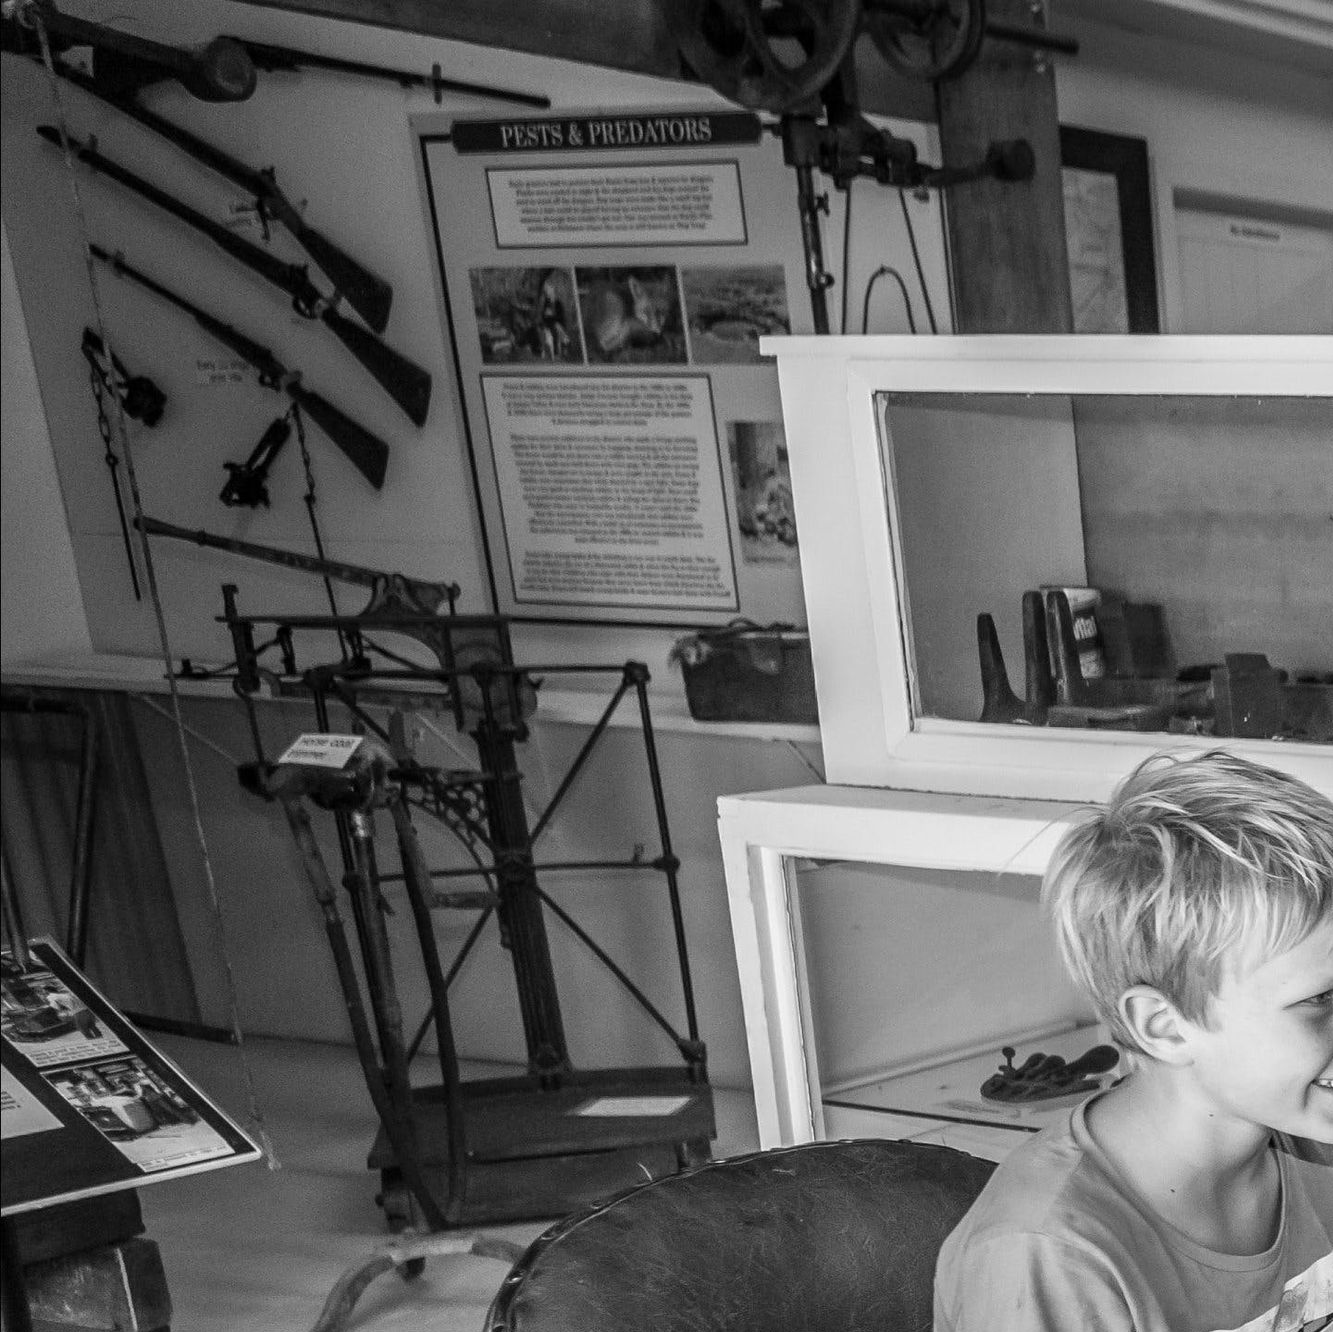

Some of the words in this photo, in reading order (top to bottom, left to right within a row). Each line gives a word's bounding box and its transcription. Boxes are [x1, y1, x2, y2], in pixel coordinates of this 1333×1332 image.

[500, 123, 564, 149] PESTS
[568, 122, 585, 146] &
[588, 117, 713, 145] PREDATORS
